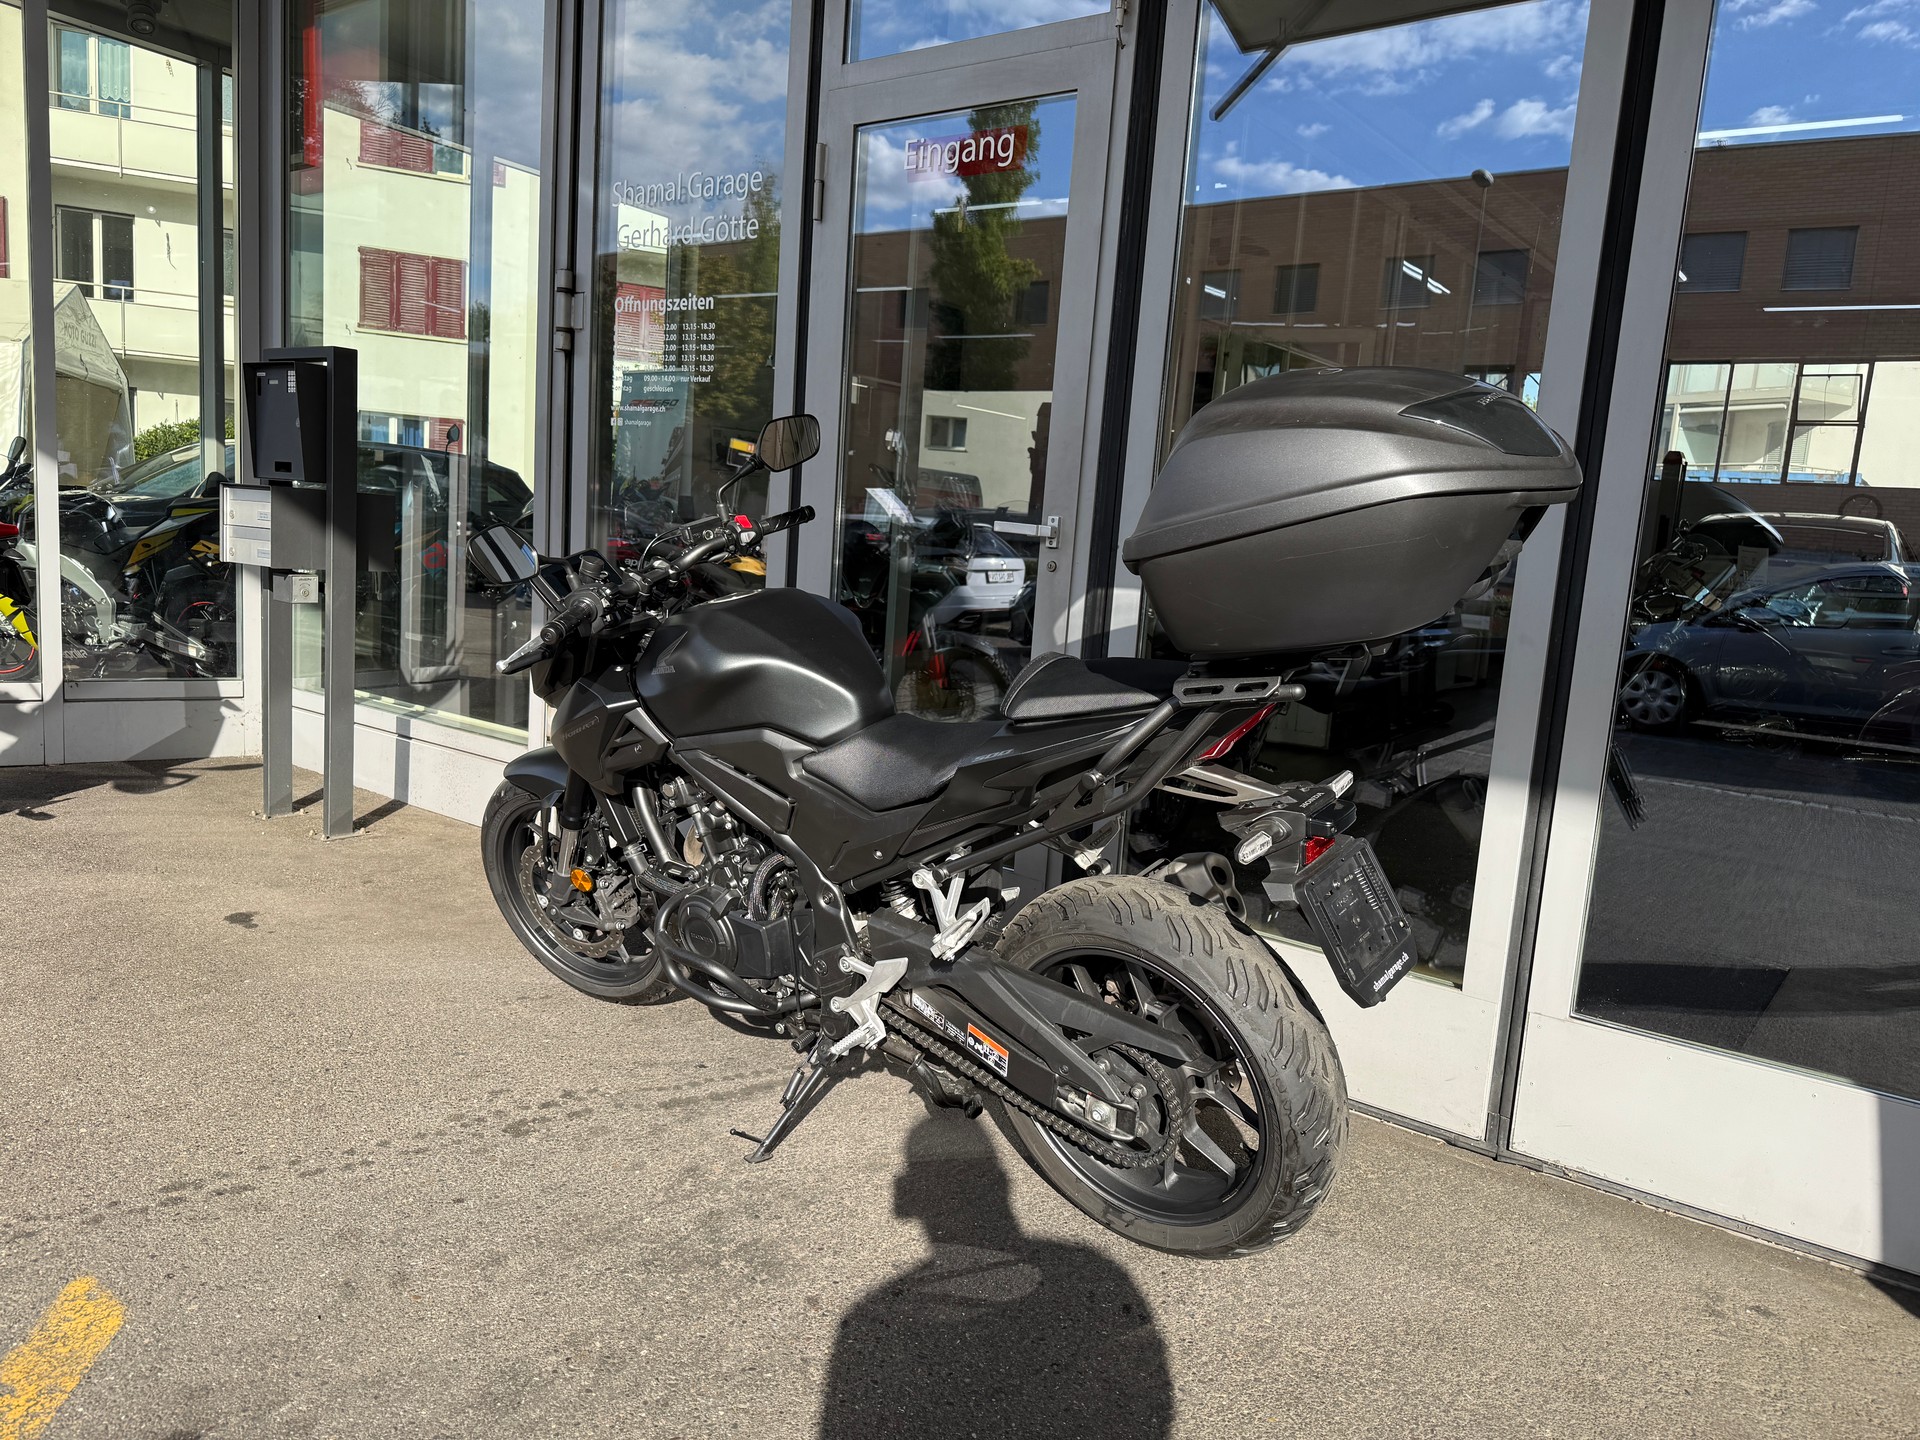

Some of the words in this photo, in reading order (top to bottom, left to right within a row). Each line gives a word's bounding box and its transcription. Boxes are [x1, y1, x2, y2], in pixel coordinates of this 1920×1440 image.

[903, 132, 1016, 174] Eingang
[612, 172, 682, 208] Shamal
[688, 169, 763, 201] Garage
[618, 216, 694, 249] Gerhard
[700, 214, 760, 243] Götte
[701, 322, 715, 330] 18.30
[682, 333, 696, 341] 13.15
[700, 333, 715, 341] 18.30
[700, 343, 715, 351] 18.30
[681, 354, 696, 362] 13.15
[699, 354, 715, 362] 18.30
[681, 364, 696, 372] 13.15
[699, 364, 714, 372] 18.30
[643, 374, 658, 383] 09.00
[661, 374, 676, 383] 14.00
[690, 374, 711, 383] Verkauf
[643, 385, 674, 394] geschlossen
[1299, 791, 1326, 809] HONDA
[1373, 951, 1410, 992] shamalgarage.ch
